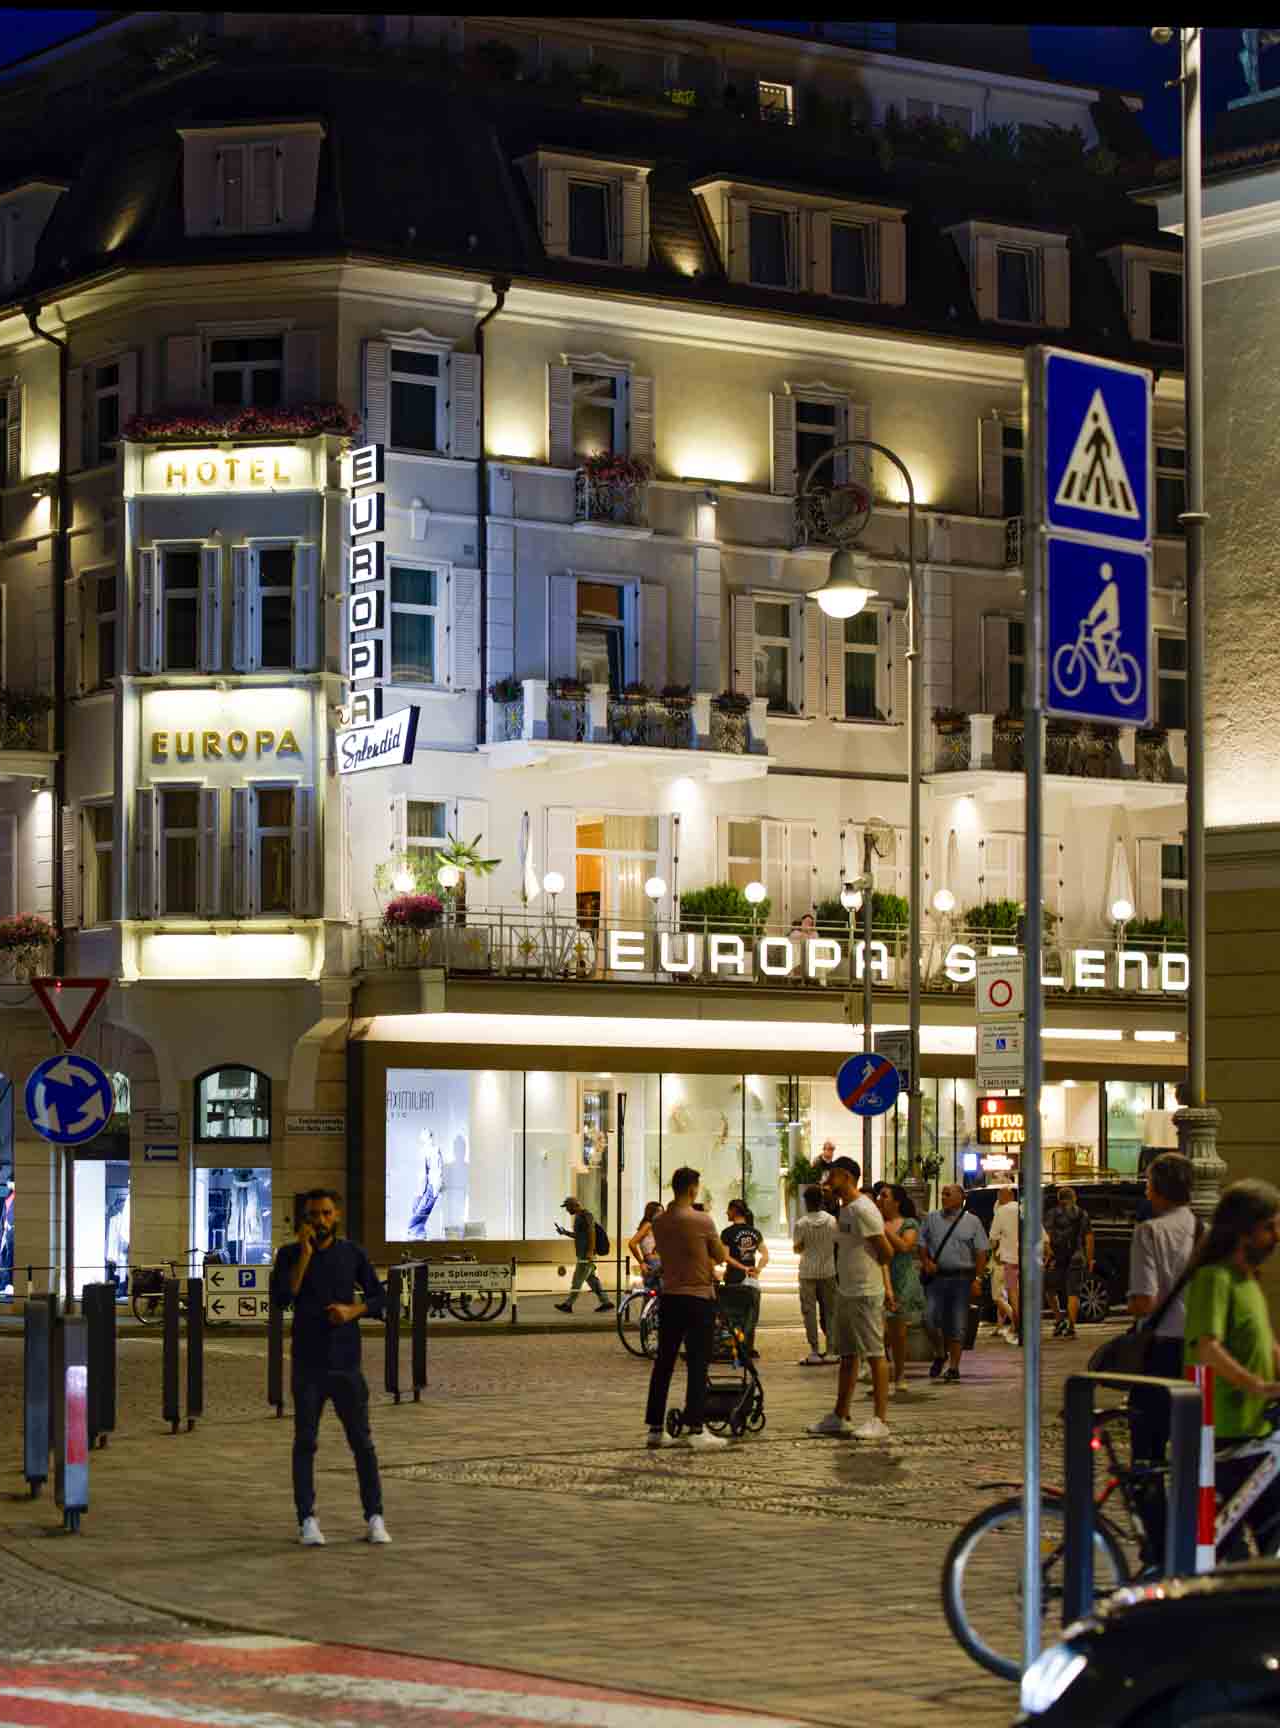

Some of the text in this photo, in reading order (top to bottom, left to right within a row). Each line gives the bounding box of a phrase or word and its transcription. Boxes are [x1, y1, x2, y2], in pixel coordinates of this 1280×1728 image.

[166, 458, 289, 487] HOTEL
[351, 451, 373, 725] EUROPA
[151, 729, 303, 760] EUROPA
[341, 726, 402, 770] Splendid
[610, 929, 889, 980] EUROPA
[981, 1114, 1023, 1128] ATTIVO
[448, 1269, 489, 1279] Splendid
